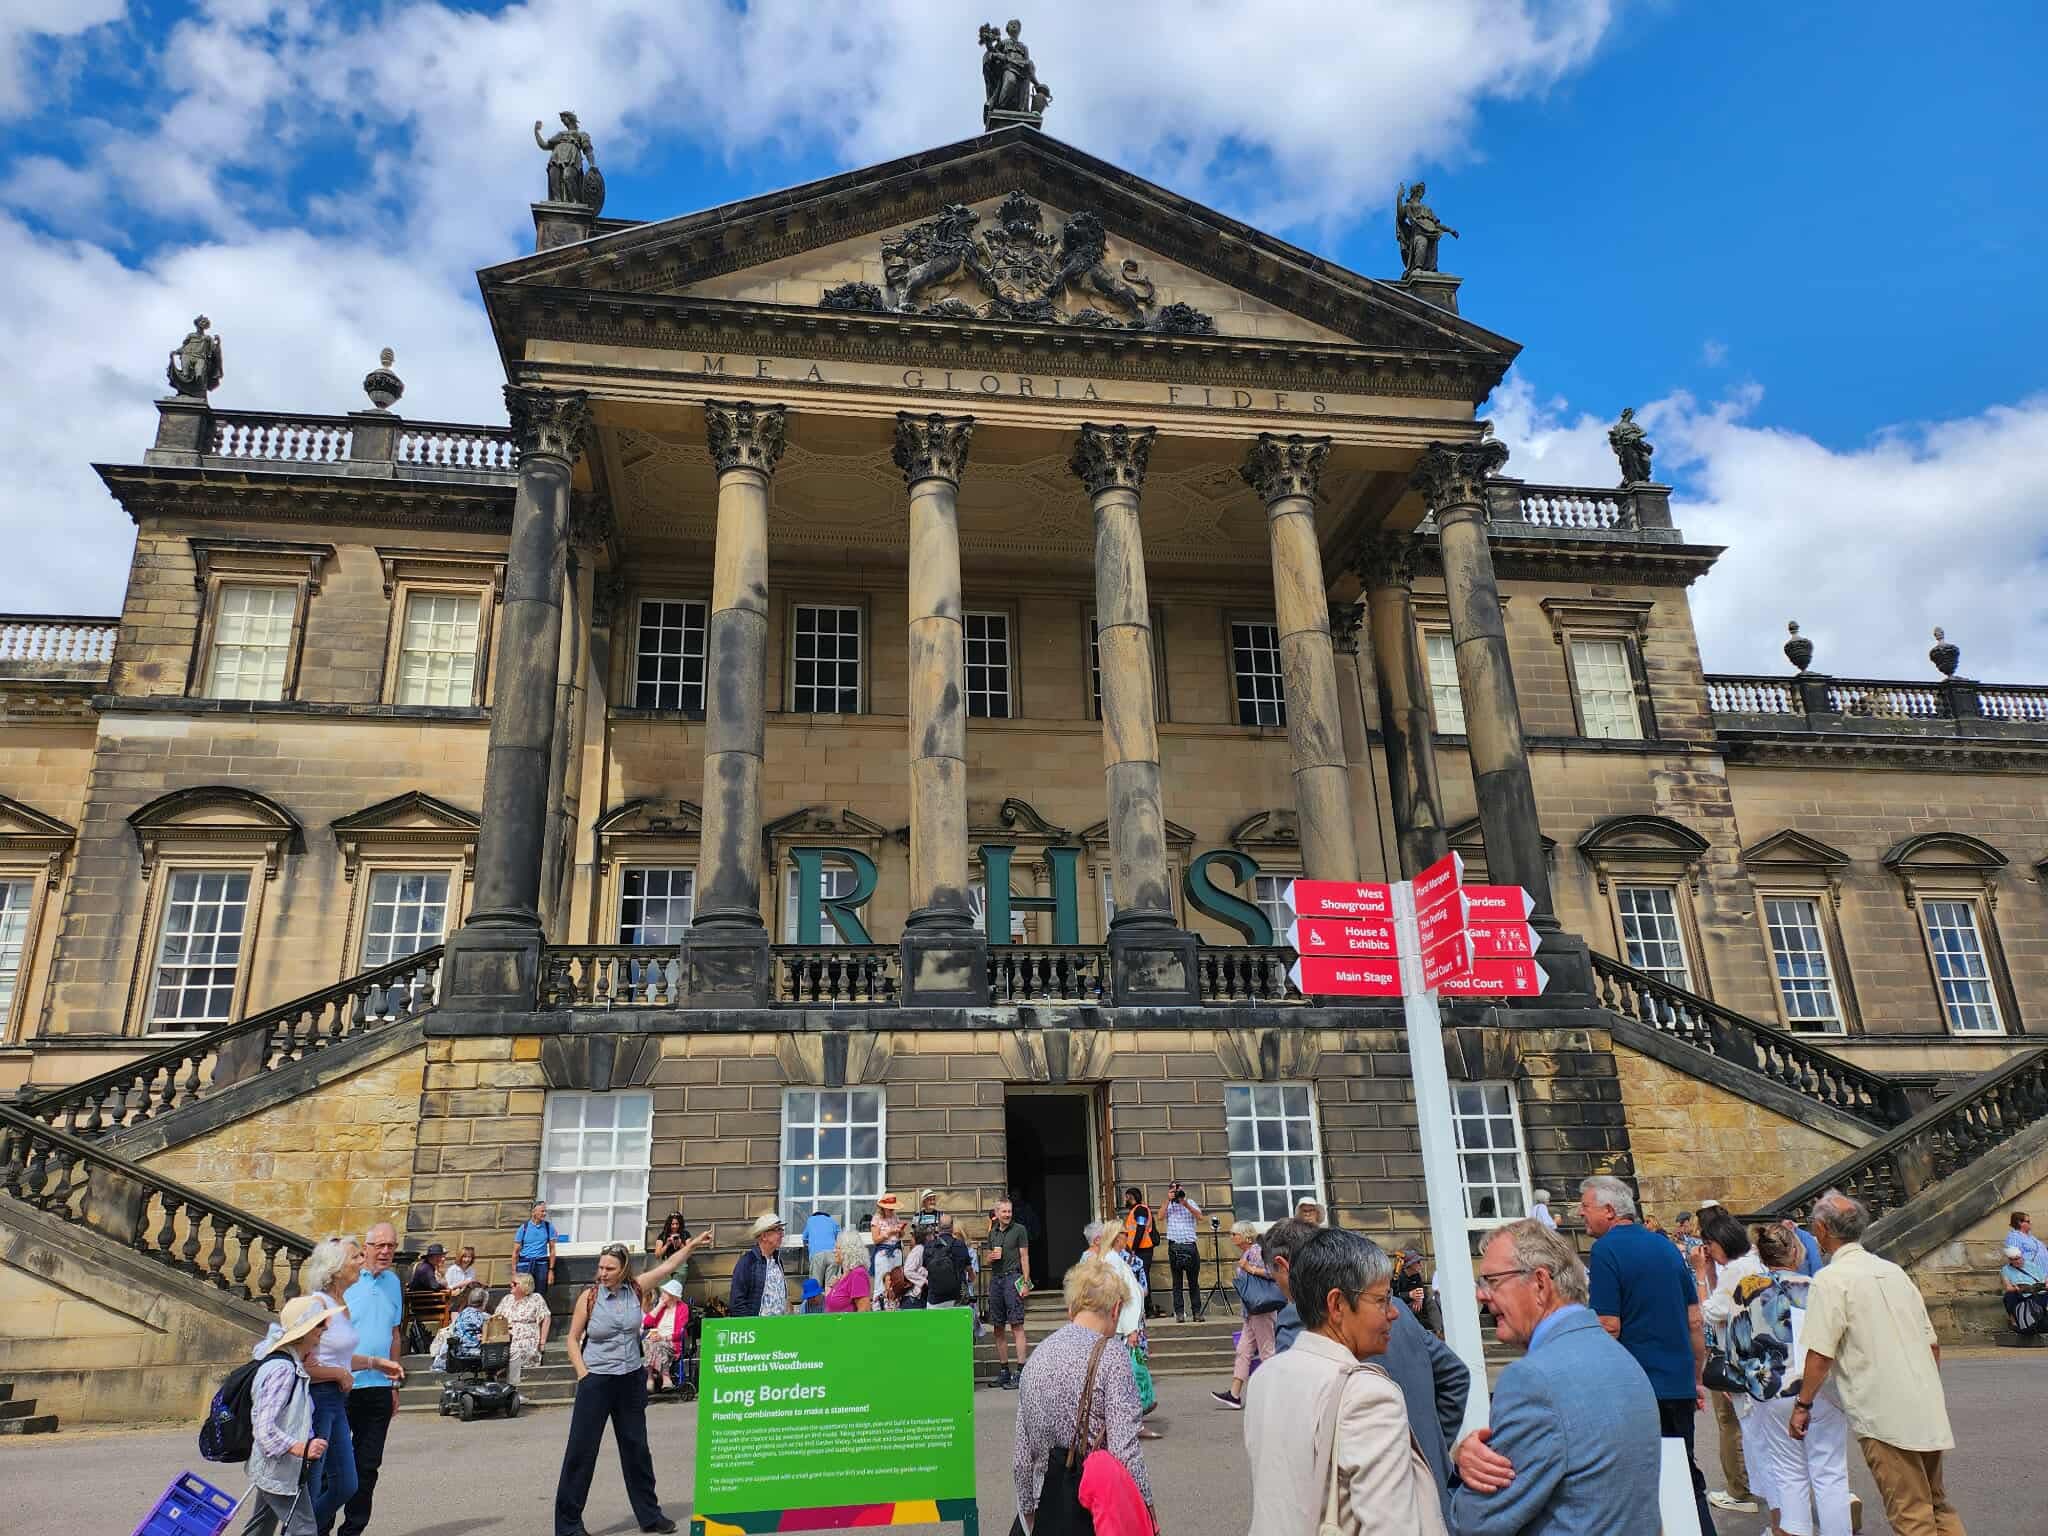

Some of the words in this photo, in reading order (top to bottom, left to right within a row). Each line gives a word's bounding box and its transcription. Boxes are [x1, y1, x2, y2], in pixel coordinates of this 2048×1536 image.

[703, 354, 825, 382] MEA
[903, 370, 1100, 400] GLORIA
[1168, 386, 1327, 413] FIDES
[789, 846, 1275, 946] RHS
[1357, 887, 1384, 899] West
[1321, 899, 1385, 913] Showground
[1345, 926, 1378, 937] House
[1379, 927, 1389, 937] &
[1349, 938, 1390, 950] Exhibits
[1336, 971, 1361, 981] Main
[1363, 971, 1393, 985] Stage
[1472, 978, 1504, 989] Court
[730, 1330, 756, 1345] RHS
[714, 1353, 737, 1364] RHS
[738, 1352, 771, 1363] Flower
[772, 1350, 799, 1361] Show
[714, 1361, 769, 1374] Wentworth
[769, 1359, 824, 1371] Woodhouse
[713, 1387, 756, 1407] Long
[760, 1383, 827, 1401] Borders
[712, 1410, 743, 1421] Planting
[744, 1408, 794, 1419] combinations
[794, 1407, 802, 1416] to
[803, 1406, 824, 1416] make
[825, 1406, 830, 1414] a
[831, 1404, 870, 1415] statement!
